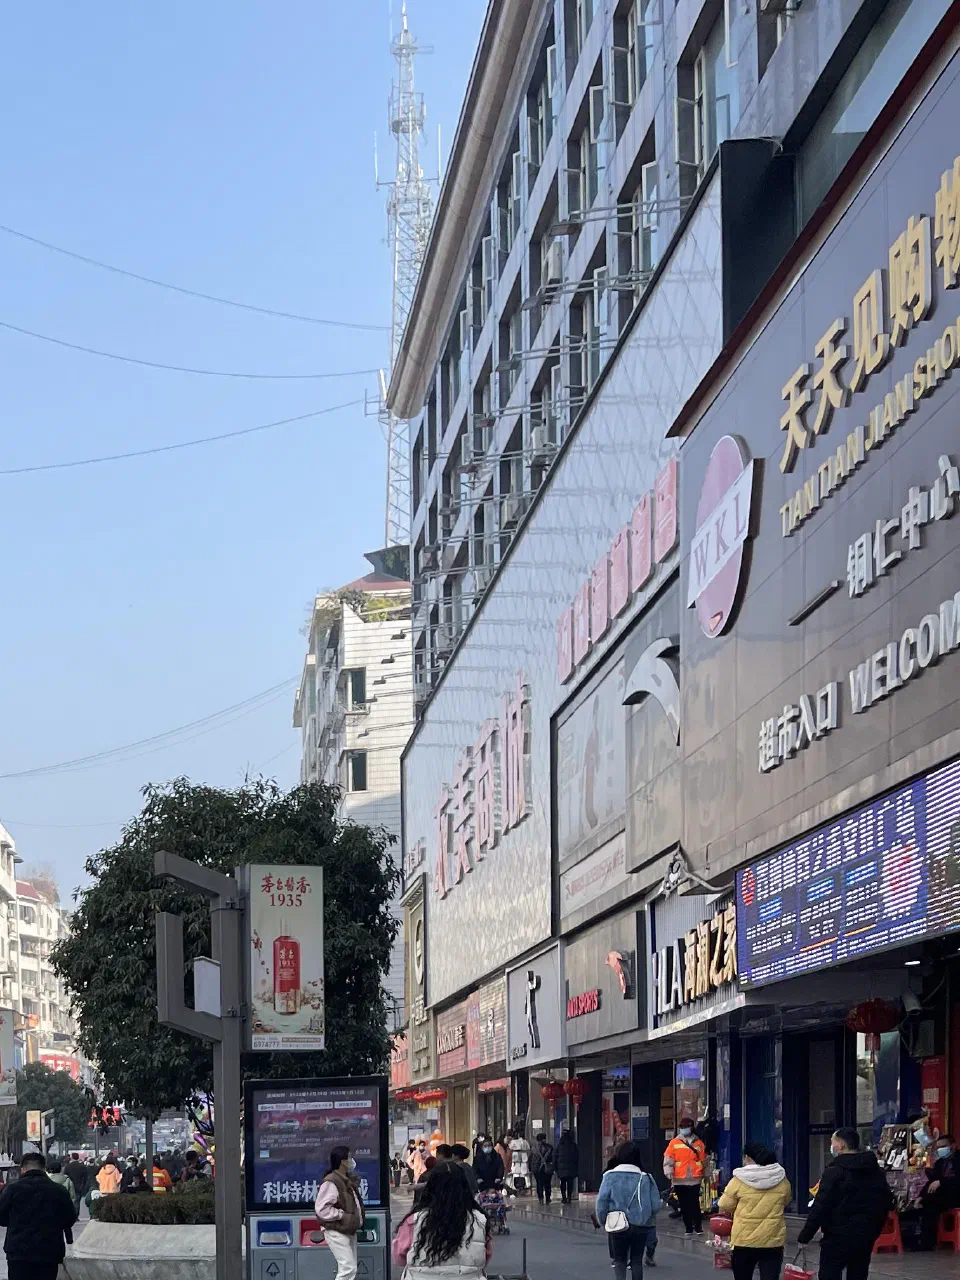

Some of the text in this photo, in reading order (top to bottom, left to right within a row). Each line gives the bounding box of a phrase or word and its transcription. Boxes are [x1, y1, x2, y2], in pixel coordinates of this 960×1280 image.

[780, 315, 960, 537] TIAN TIAN JIAN SHO
[693, 490, 748, 586] WKL
[847, 454, 960, 598] 铜仁中心
[759, 682, 841, 773] 超市入口
[270, 893, 303, 907] 1935
[652, 935, 684, 1016] HLA
[684, 902, 738, 1003] 海澜之家
